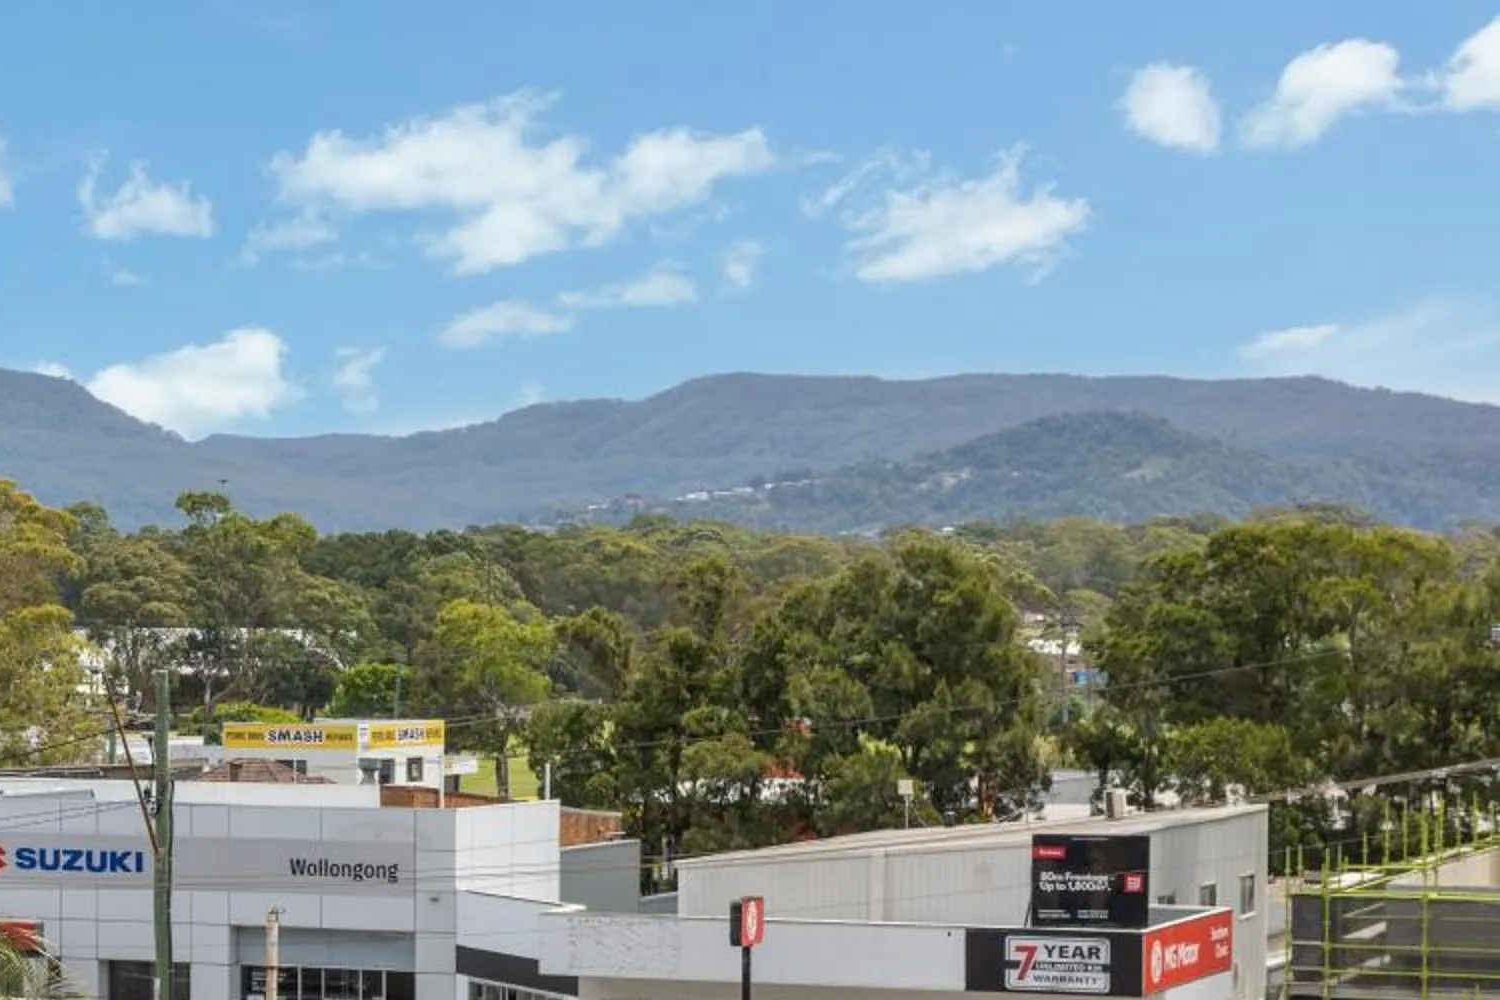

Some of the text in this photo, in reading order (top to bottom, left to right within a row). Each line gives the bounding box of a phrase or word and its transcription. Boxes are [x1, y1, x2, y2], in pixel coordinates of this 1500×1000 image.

[267, 729, 324, 743] SMASH
[15, 847, 143, 873] SUZUKI
[289, 858, 399, 883] Wollongong
[1014, 944, 1101, 981] 7 YEAR
[1164, 944, 1177, 971] MG
[1177, 943, 1200, 968] Motor
[1033, 974, 1098, 985] WARRANTY
